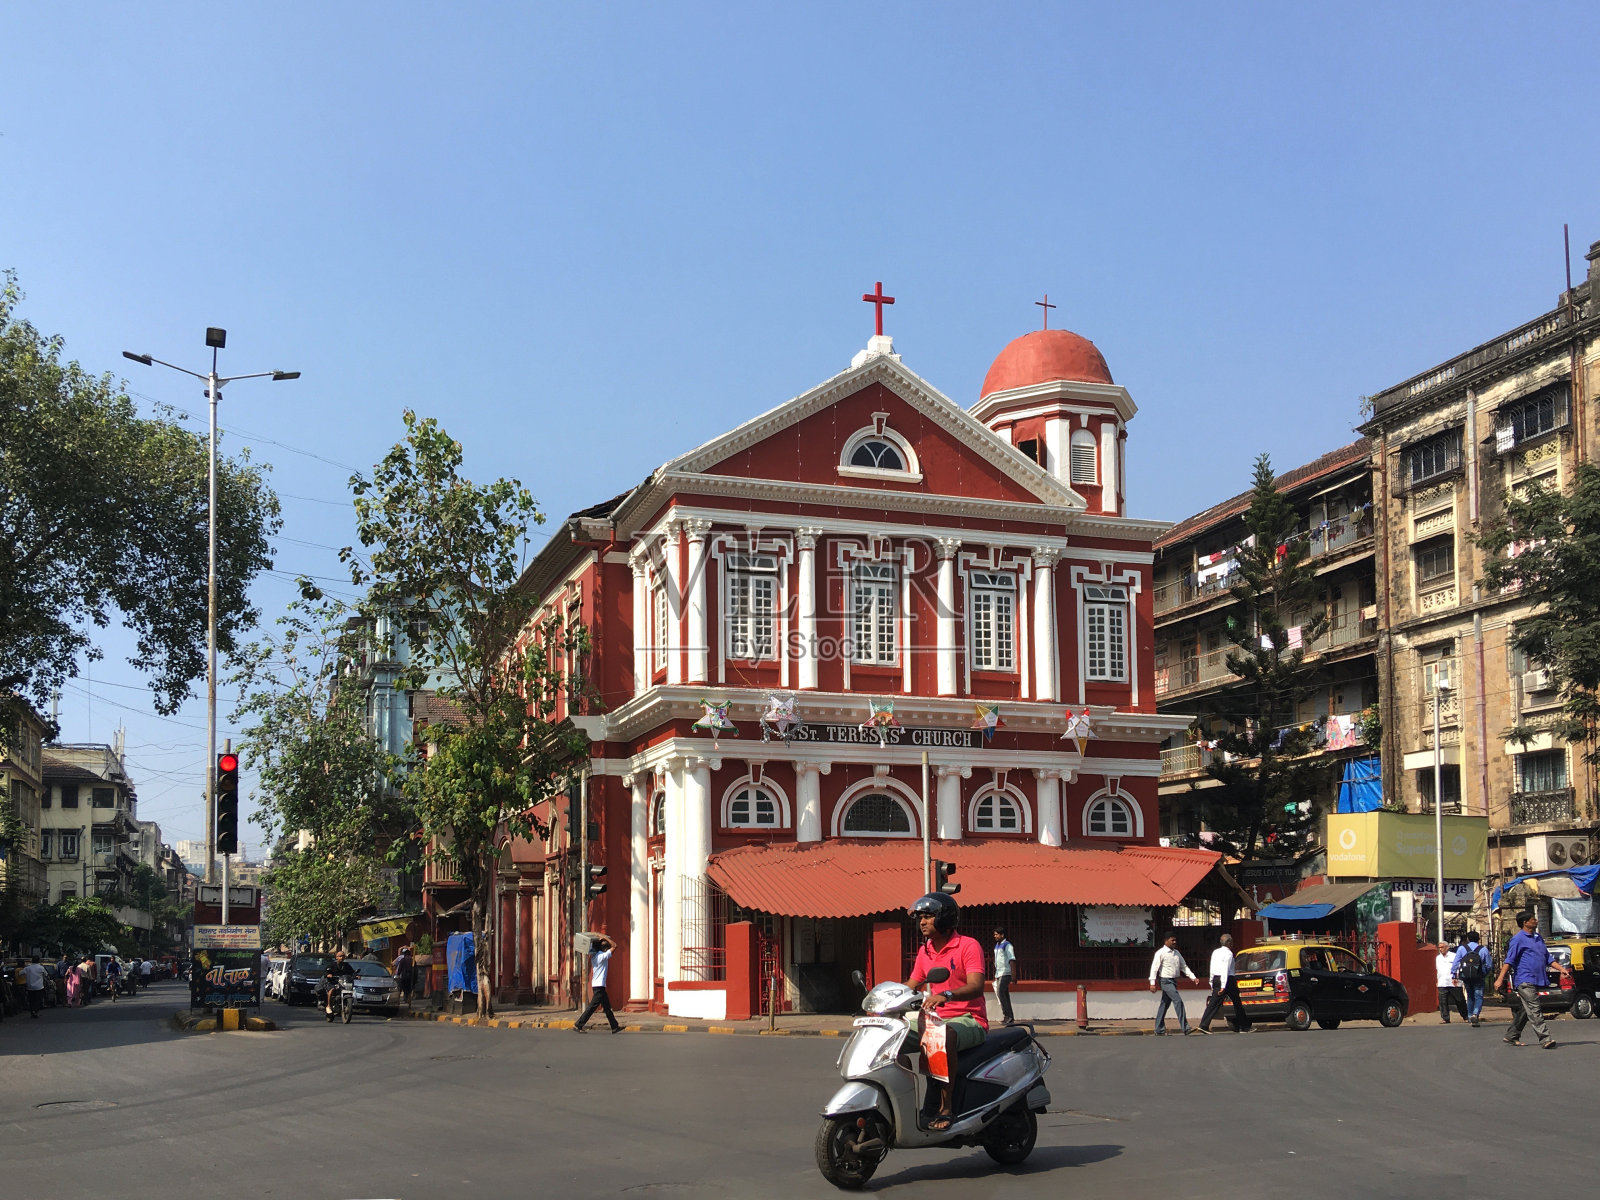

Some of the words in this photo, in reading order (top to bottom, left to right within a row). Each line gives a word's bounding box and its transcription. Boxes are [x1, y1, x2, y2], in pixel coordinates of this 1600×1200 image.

[912, 729, 972, 747] CHURCH
[1330, 853, 1366, 861] vodafone
[1284, 869, 1296, 877] YOU
